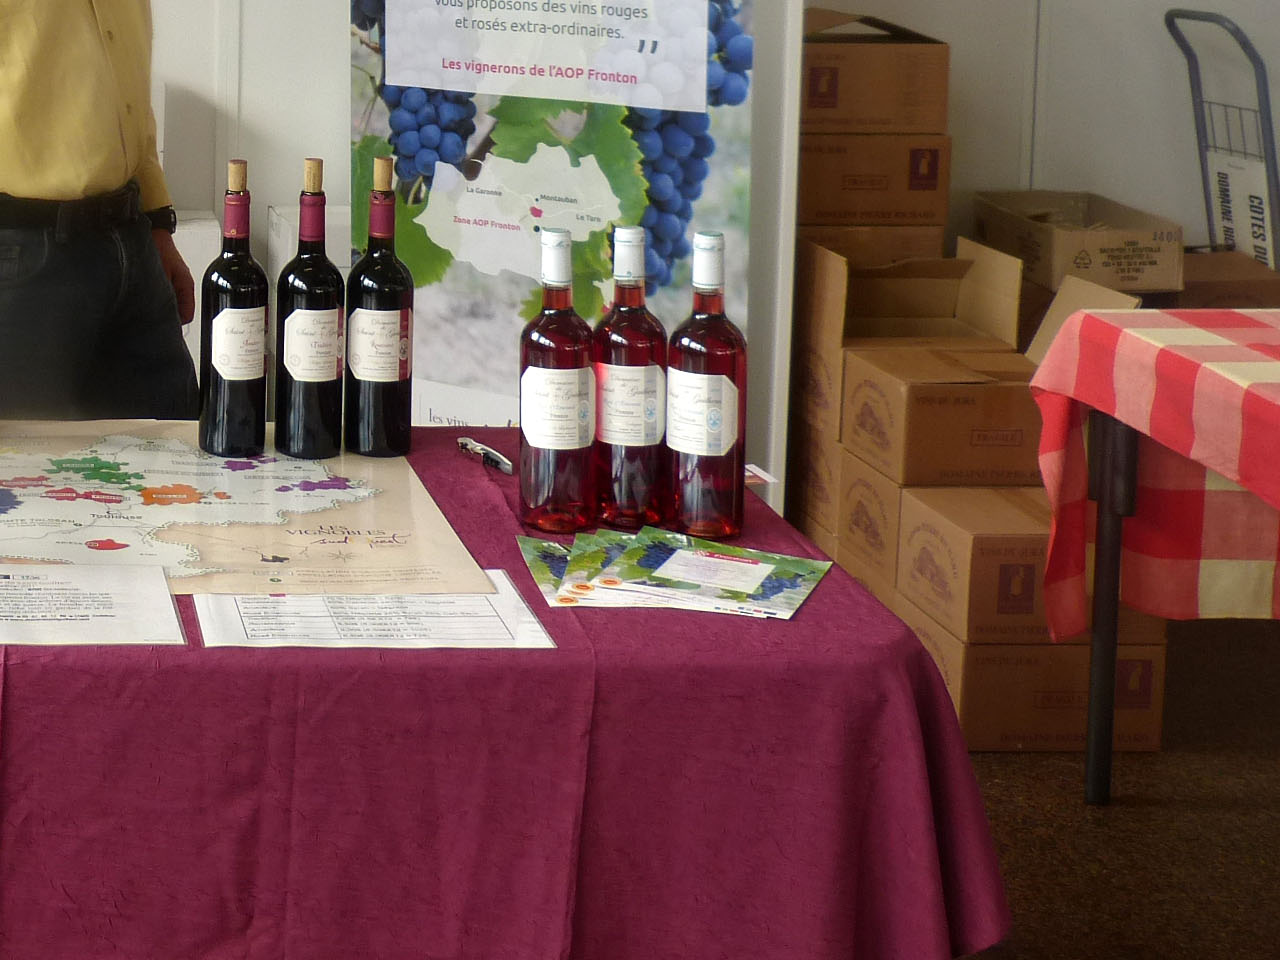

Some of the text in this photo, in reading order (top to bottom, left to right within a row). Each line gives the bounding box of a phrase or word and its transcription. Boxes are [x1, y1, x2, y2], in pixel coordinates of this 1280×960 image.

[543, 0, 566, 13] des
[570, 0, 597, 15] vins
[601, 4, 648, 20] rouges
[455, 18, 625, 39] et rosés extra-ordinaires.
[442, 58, 462, 70] Les
[465, 59, 526, 76] vignerons
[529, 64, 545, 77] de
[588, 69, 638, 85] Fronton
[453, 215, 521, 231] Zone AOP Fronton
[429, 408, 443, 424] les
